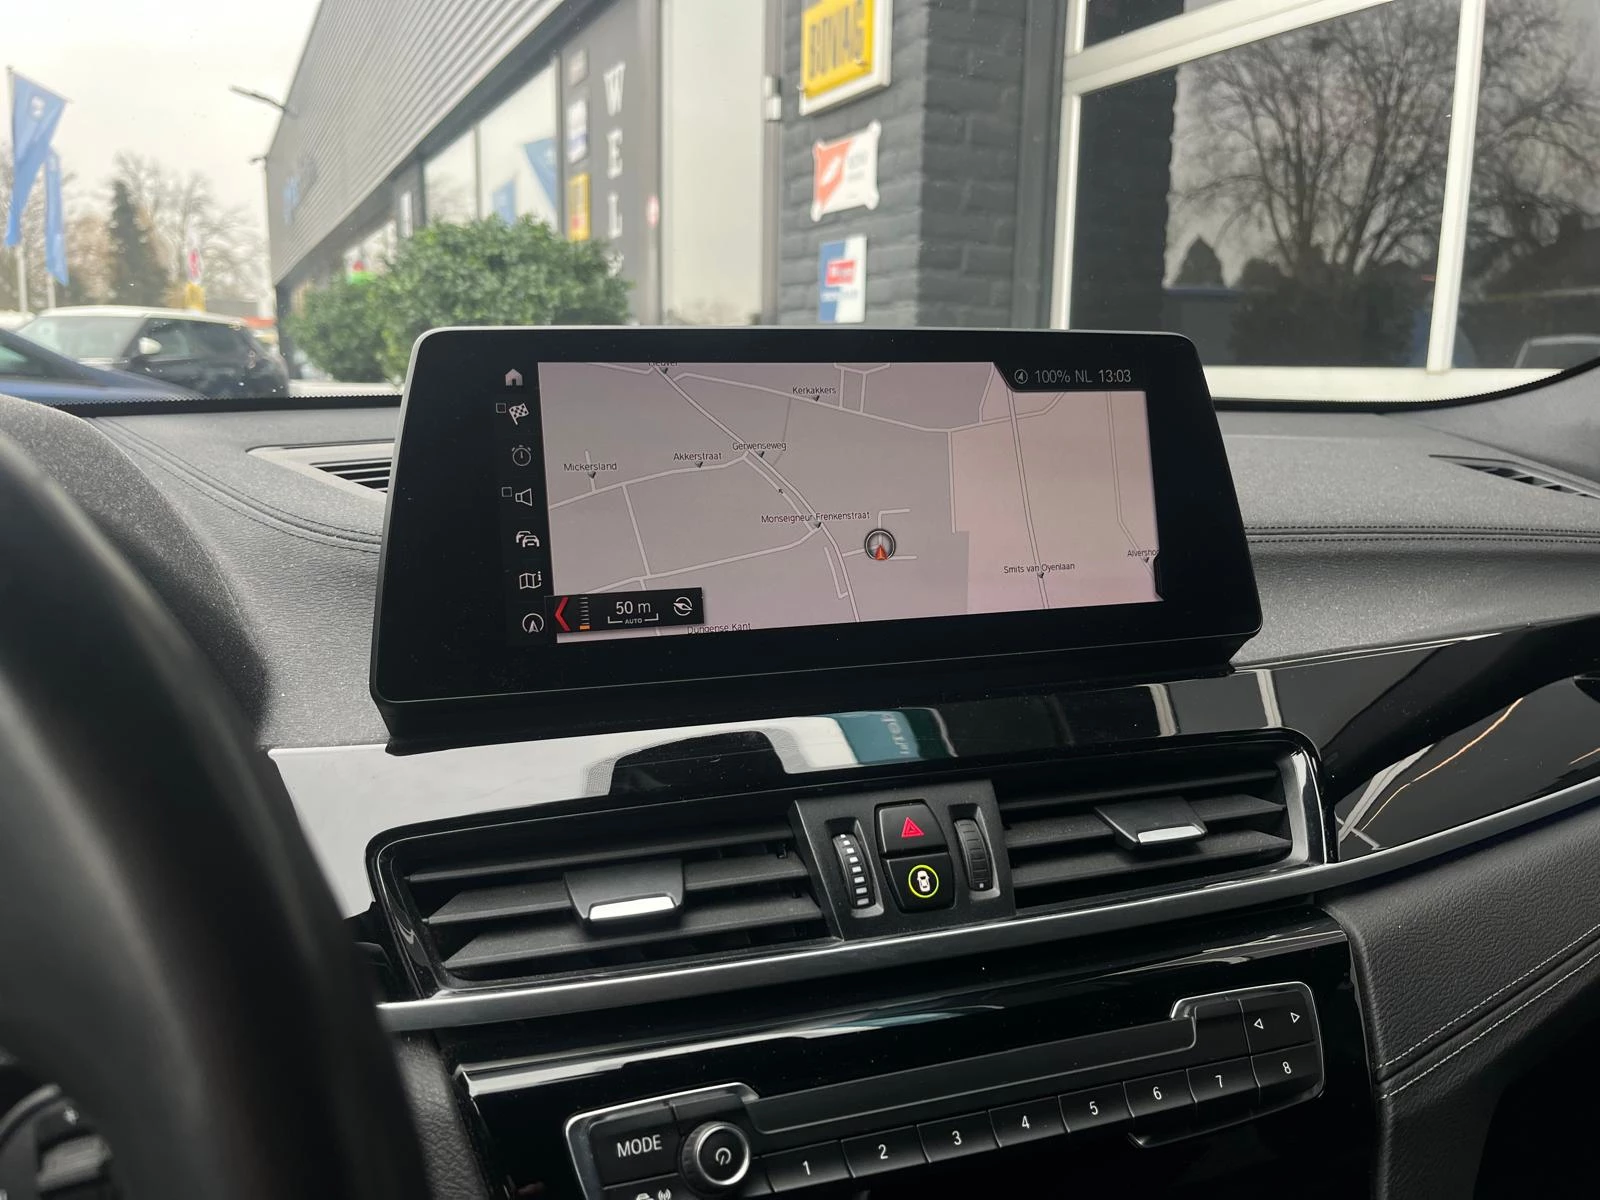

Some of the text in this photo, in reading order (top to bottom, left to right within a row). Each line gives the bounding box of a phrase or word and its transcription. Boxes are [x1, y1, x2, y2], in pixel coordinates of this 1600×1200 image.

[1035, 369, 1132, 383] 100% NL 13:03
[792, 386, 837, 395] Kerkakkers
[732, 442, 787, 452] Gerwenseweg
[673, 452, 722, 461] Akkerstraat
[563, 462, 617, 471] Mickersland
[761, 511, 870, 524] Monseigneur Frenkenstraat
[1003, 565, 1025, 574] Smits
[1041, 562, 1075, 573] Oyenlaan
[615, 600, 651, 615] 50 m
[624, 617, 643, 625] AUTO
[1282, 1060, 1292, 1075] 8
[1215, 1074, 1224, 1089] 7
[1152, 1086, 1163, 1101] 6
[1088, 1101, 1099, 1116] 5
[1021, 1114, 1031, 1130] 4
[952, 1130, 963, 1146] 3
[616, 1134, 663, 1158] MODE
[877, 1144, 889, 1160] 2
[802, 1160, 812, 1176] 1
